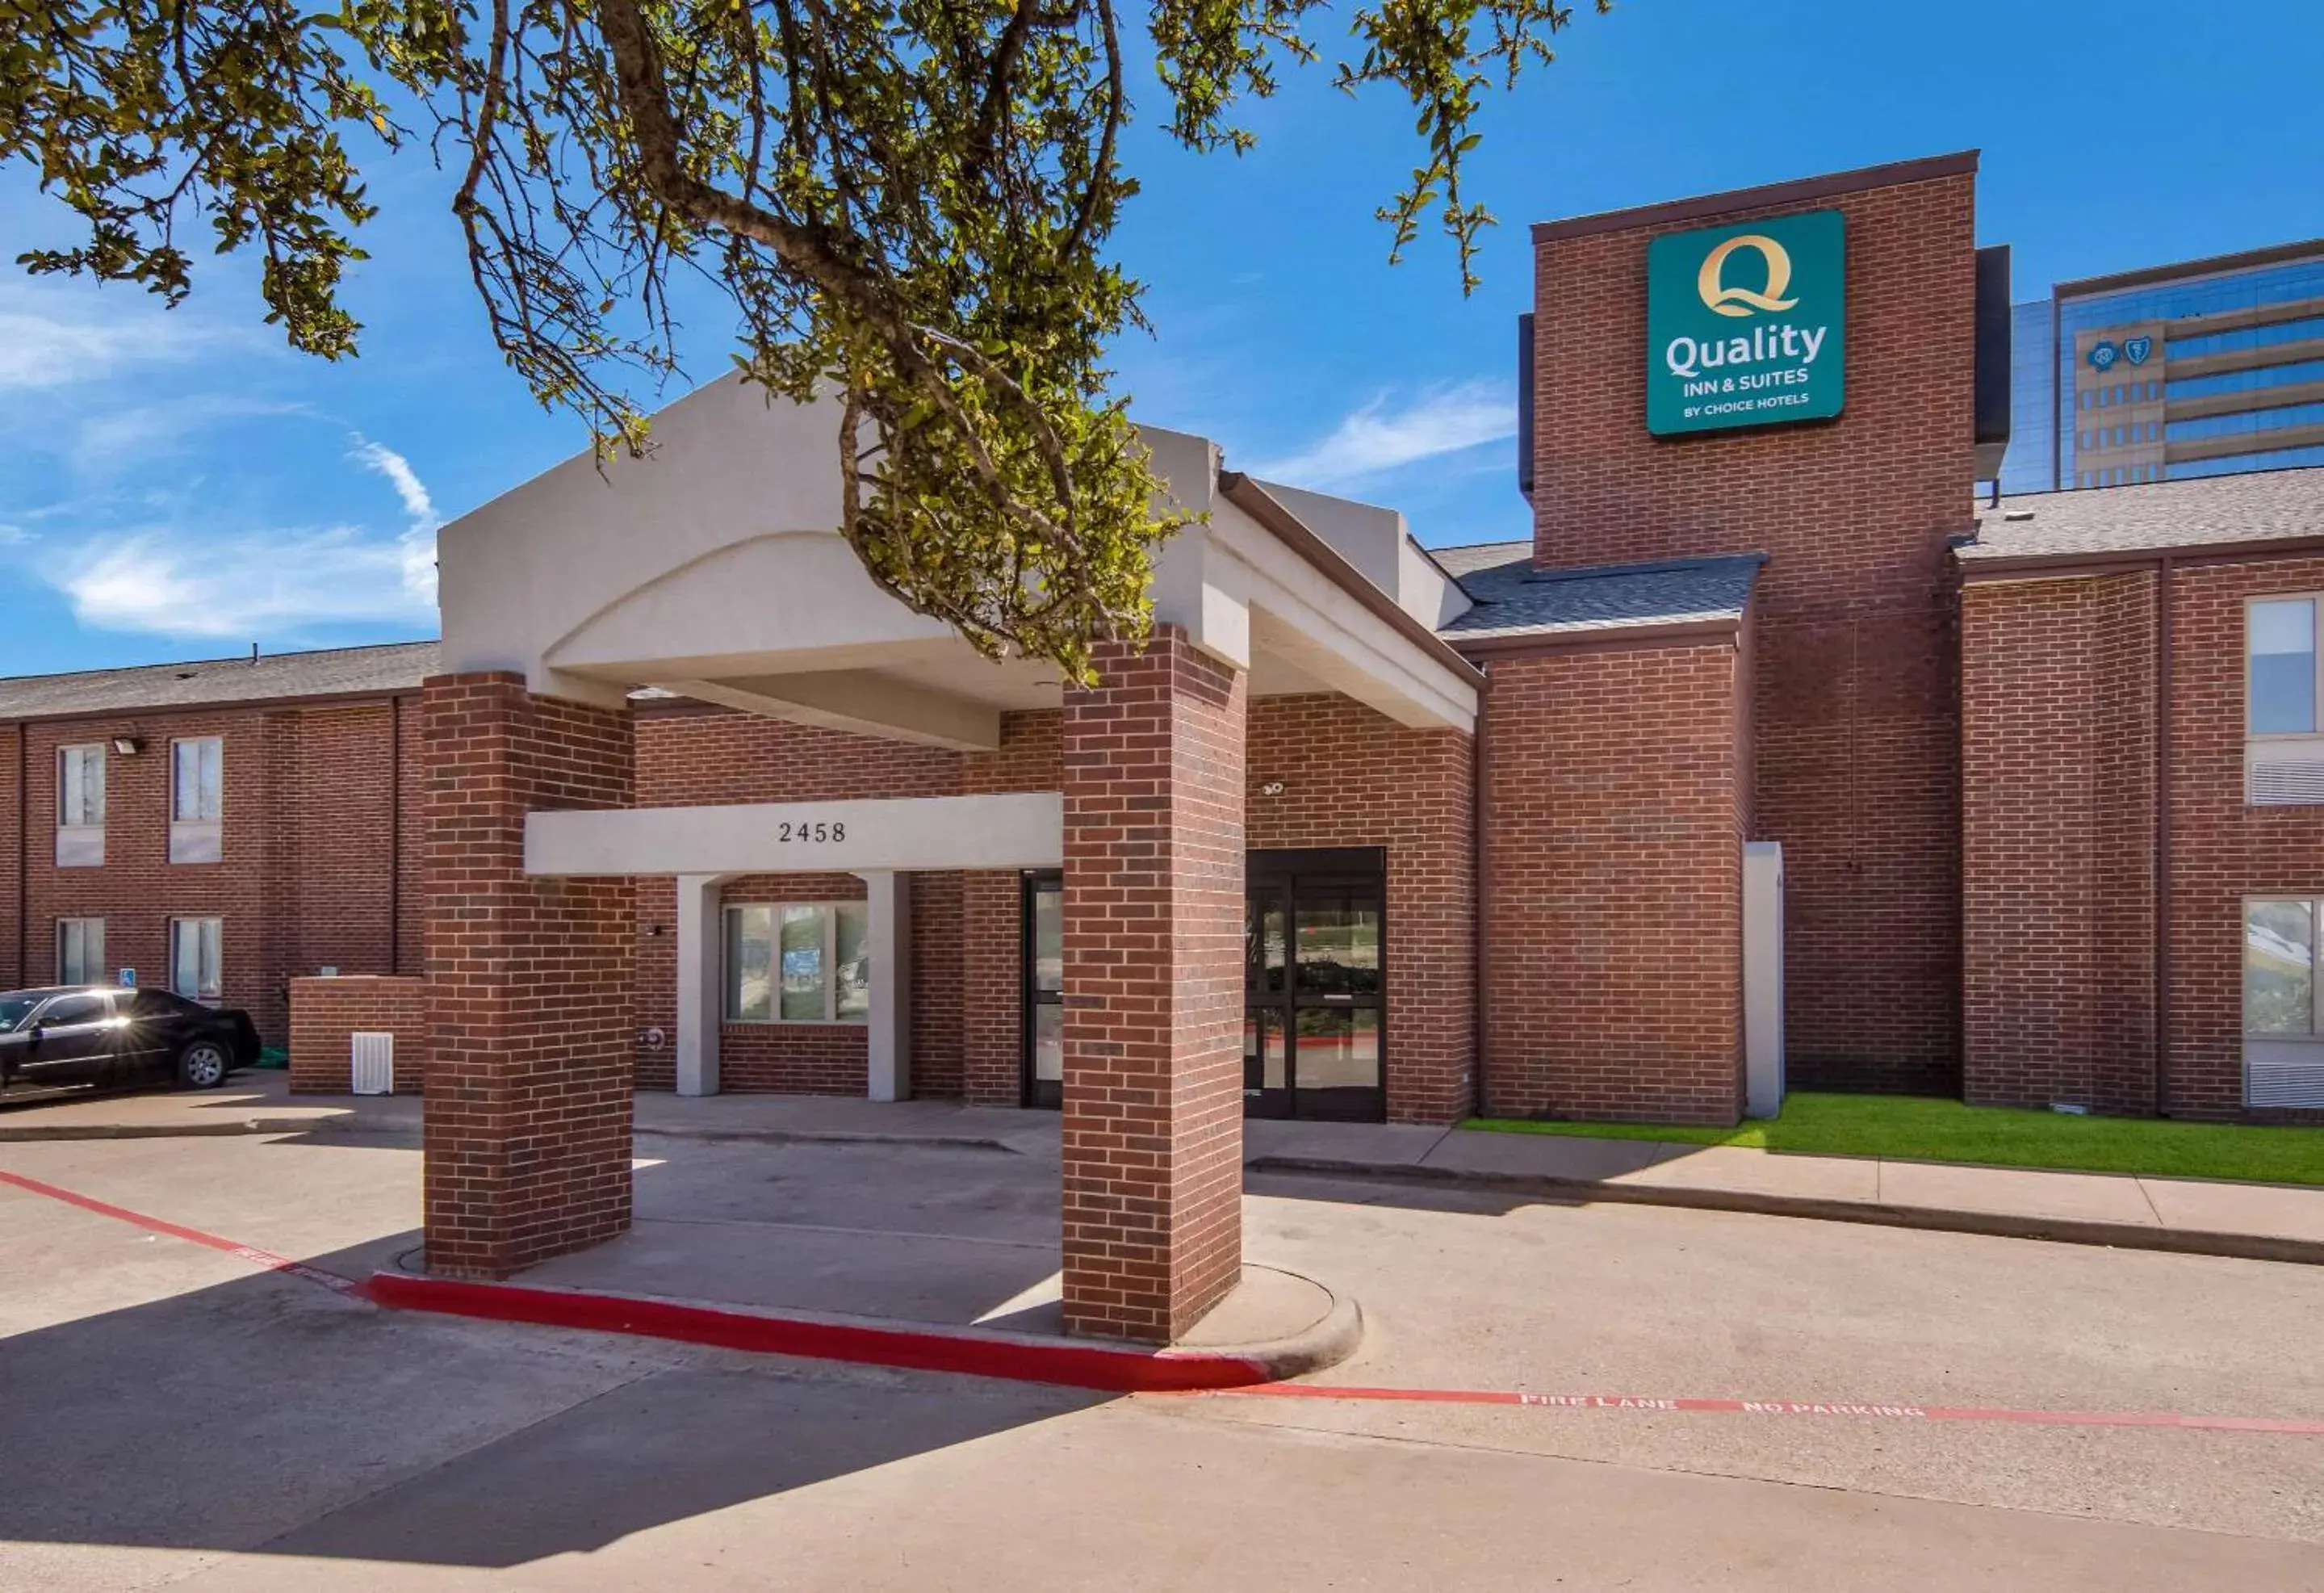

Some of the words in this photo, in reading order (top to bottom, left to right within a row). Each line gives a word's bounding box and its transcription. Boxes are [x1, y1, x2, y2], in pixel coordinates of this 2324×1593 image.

[1698, 235, 1799, 317] Q
[1666, 325, 1827, 377] Quality
[1684, 379, 1718, 397] INN
[1722, 377, 1735, 392] &
[1739, 367, 1809, 390] SUITES
[1684, 406, 1701, 418] BY
[1704, 399, 1754, 415] CHOICE
[1757, 392, 1809, 409] HOTELS
[779, 822, 845, 842] 2458
[1595, 1396, 1677, 1410] LANE
[1742, 1401, 1783, 1412] NO
[1790, 1402, 1926, 1417] PARKING
